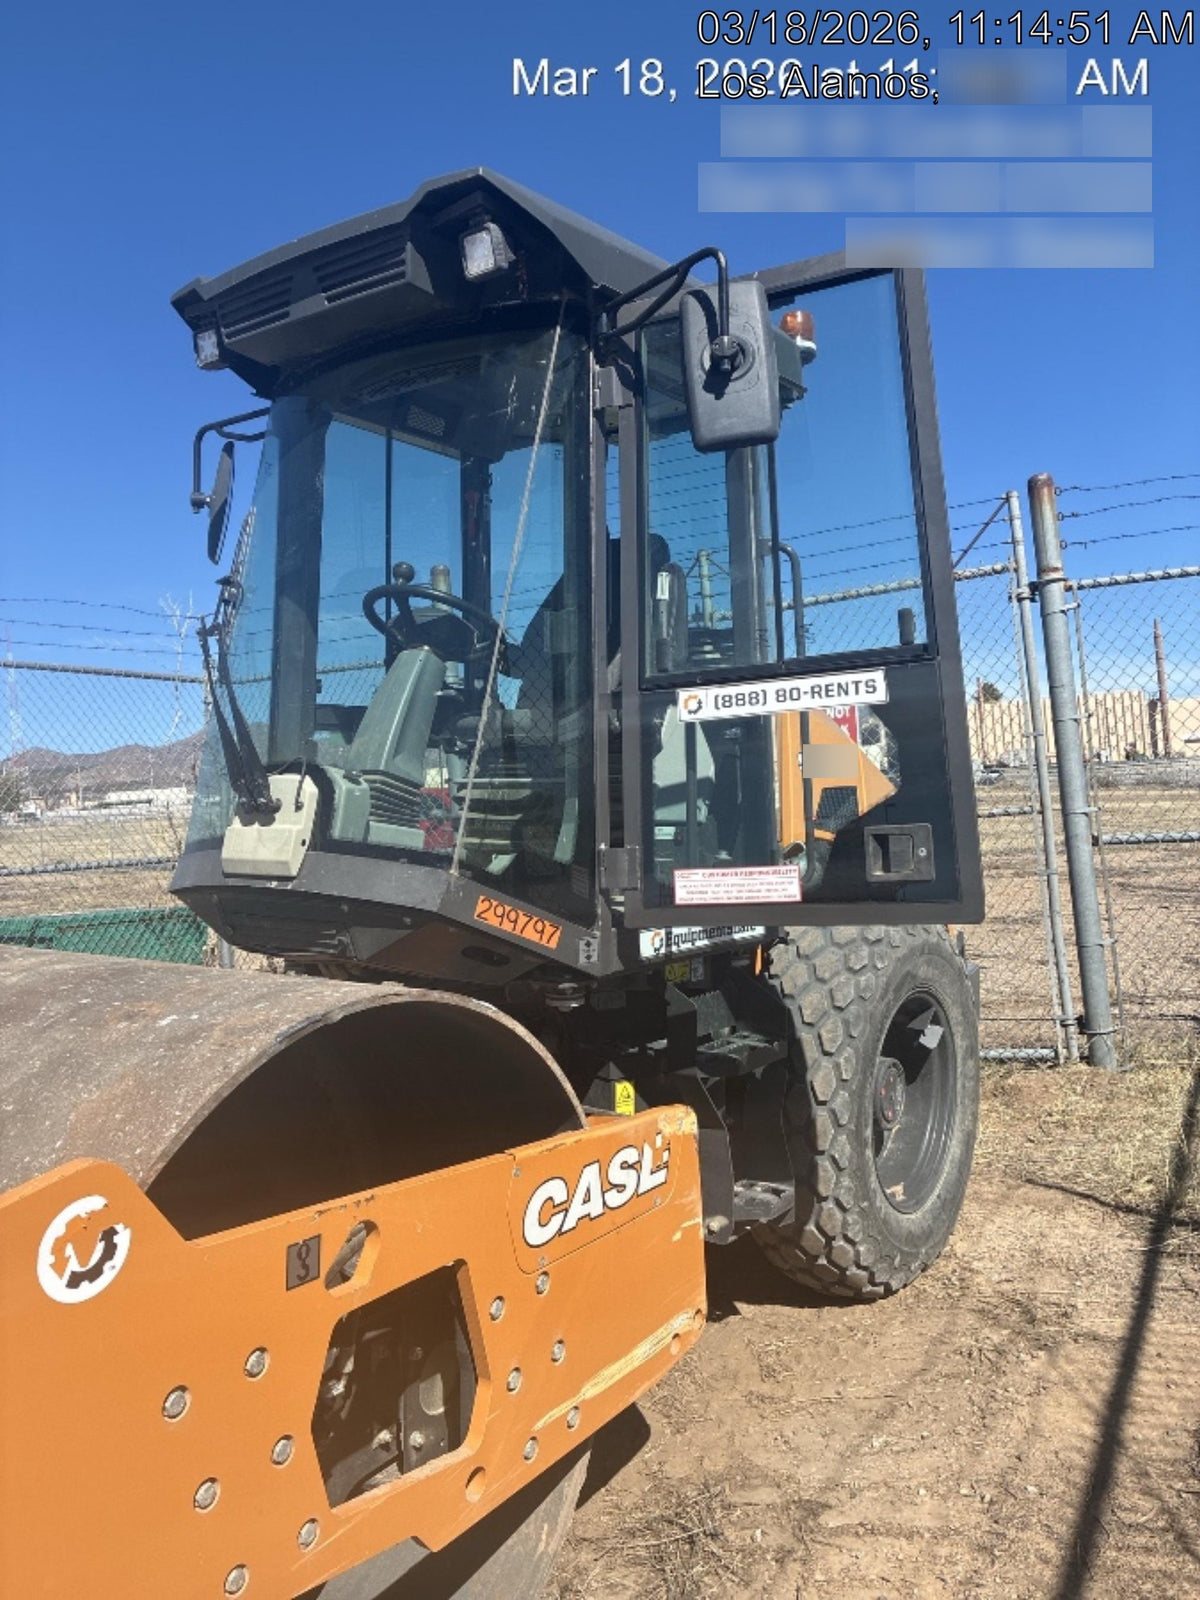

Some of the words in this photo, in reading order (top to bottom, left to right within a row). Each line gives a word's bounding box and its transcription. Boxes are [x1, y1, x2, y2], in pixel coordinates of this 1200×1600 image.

[714, 689, 767, 710] (888)
[775, 679, 878, 702] 80-RENTS
[476, 897, 560, 945] 299797
